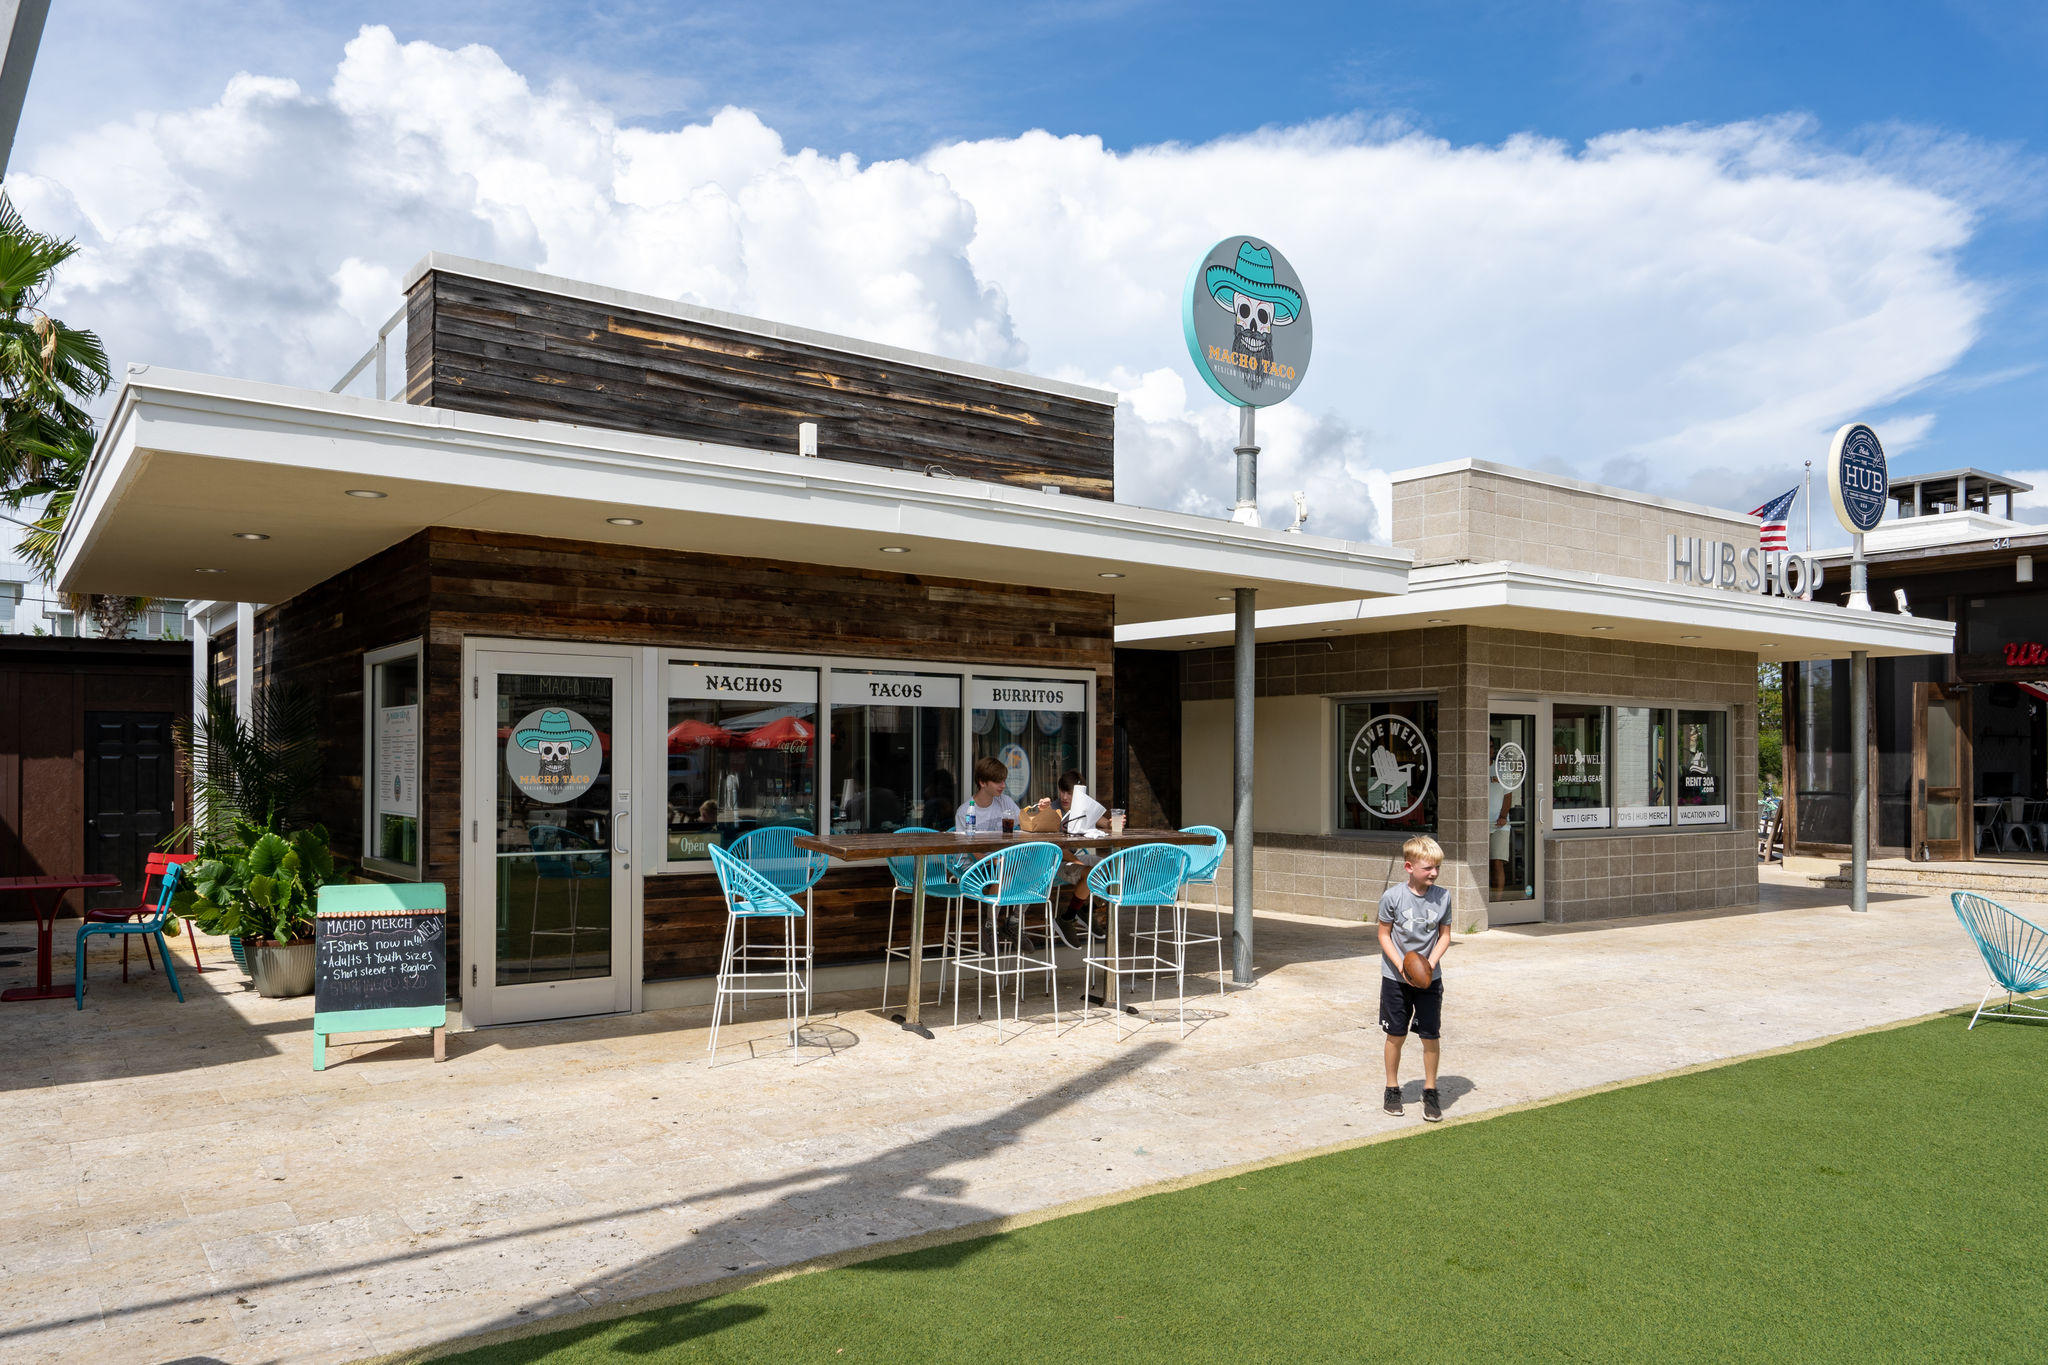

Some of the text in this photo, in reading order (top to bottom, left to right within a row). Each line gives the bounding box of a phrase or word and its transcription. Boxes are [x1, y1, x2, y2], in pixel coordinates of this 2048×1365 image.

[1208, 344, 1296, 381] MACHO TACO
[1844, 463, 1883, 493] HUB
[1992, 537, 2011, 550] 34
[1667, 534, 1824, 600] HUB SHOP
[705, 675, 783, 693] NACHOS
[869, 682, 923, 698] TACOS
[992, 688, 1064, 704] BURRITOS
[1356, 722, 1422, 755] LIVE WELL
[1498, 761, 1524, 772] HUB
[1554, 754, 1606, 765] LIVE WELL
[520, 775, 590, 785] MACHO TACO
[1685, 776, 1715, 787] RENT 30A
[1381, 800, 1401, 813] 30A
[1680, 810, 1720, 819] VACATION INFO
[1562, 814, 1598, 823] YETI GIFTS
[1636, 812, 1648, 821] HUB
[1648, 811, 1668, 820] MERCH
[680, 837, 705, 854] Open
[327, 918, 413, 934] MACHO MERCH
[417, 915, 444, 942] NEW!
[326, 940, 369, 954] T-Shirts
[376, 940, 401, 950] now
[328, 955, 362, 968] Adults
[374, 951, 402, 964] Youth
[405, 951, 433, 962] sizes
[333, 967, 358, 980] Short
[360, 965, 386, 976] sleeve
[400, 963, 437, 979] Raglan
